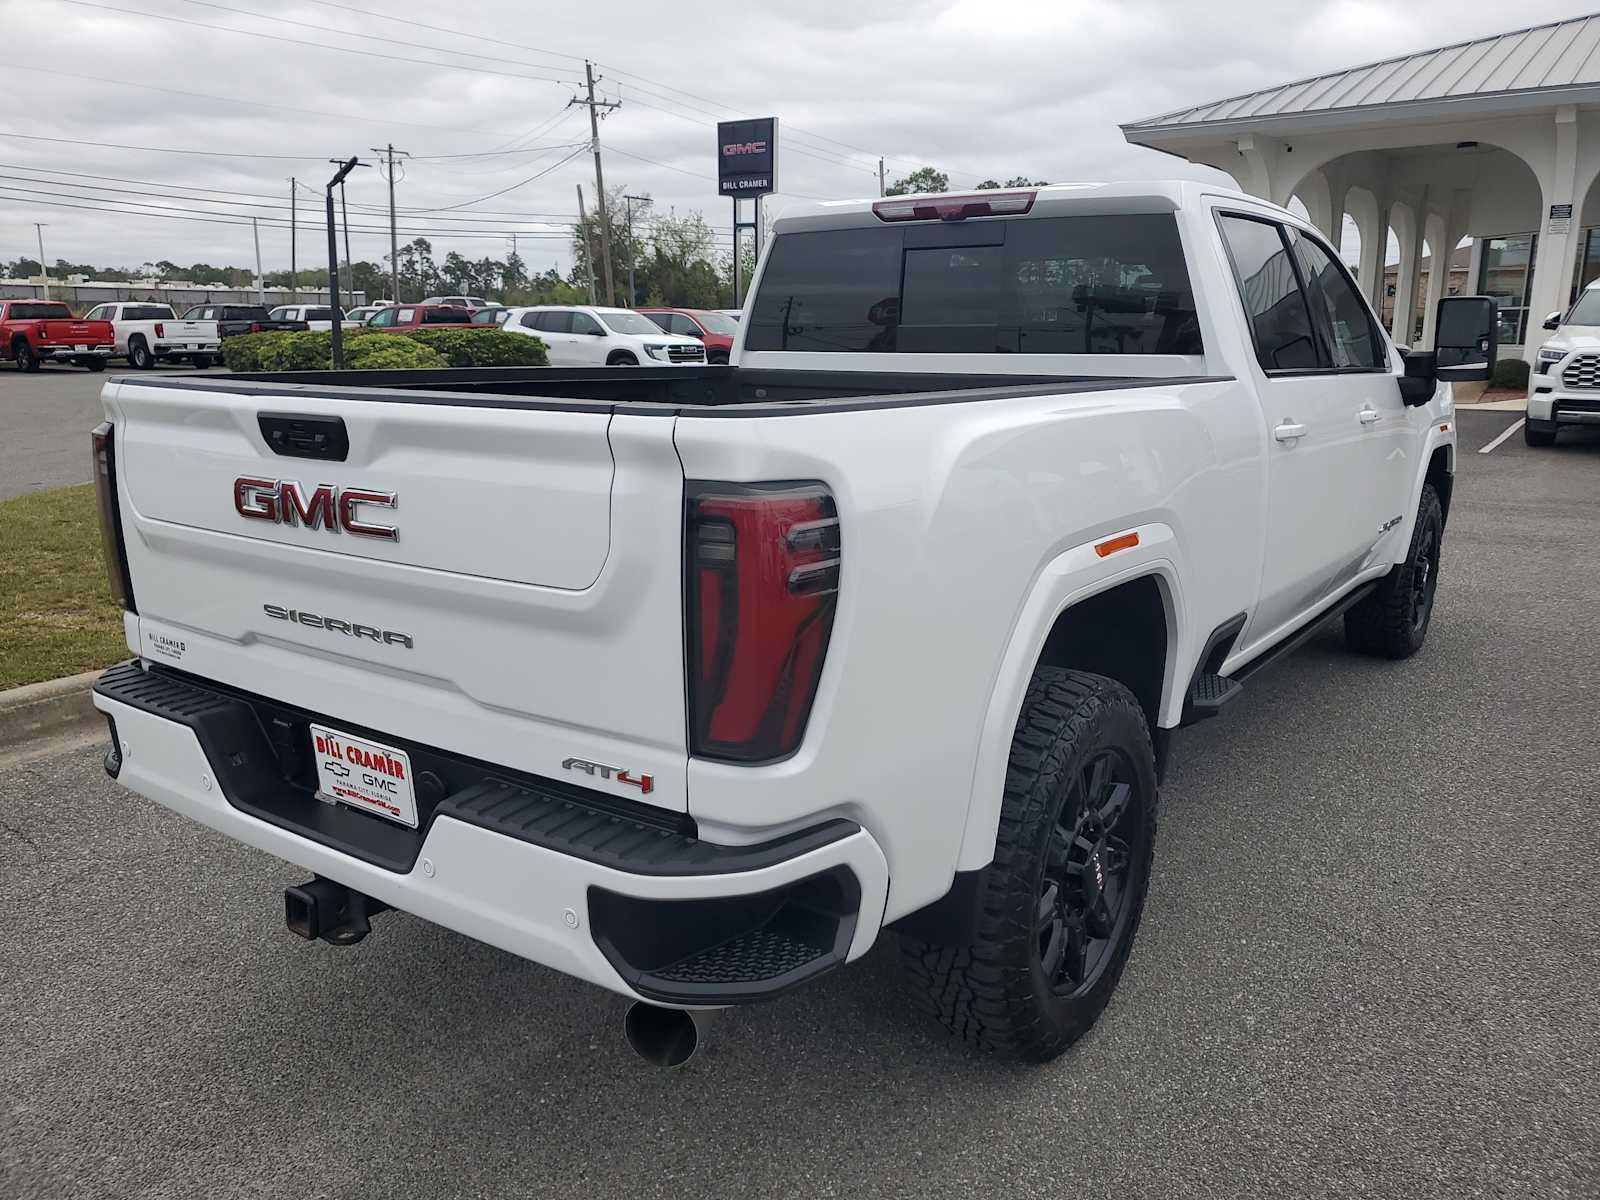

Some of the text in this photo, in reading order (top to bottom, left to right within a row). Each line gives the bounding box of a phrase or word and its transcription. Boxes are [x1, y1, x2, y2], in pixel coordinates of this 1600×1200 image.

[723, 142, 766, 156] GMC
[722, 180, 768, 190] BILL CRAMER
[234, 475, 400, 543] GMC
[263, 603, 414, 649] SIERRA
[316, 736, 404, 780] BILL CRAMER
[562, 757, 654, 794] AT4
[362, 774, 398, 794] GMC
